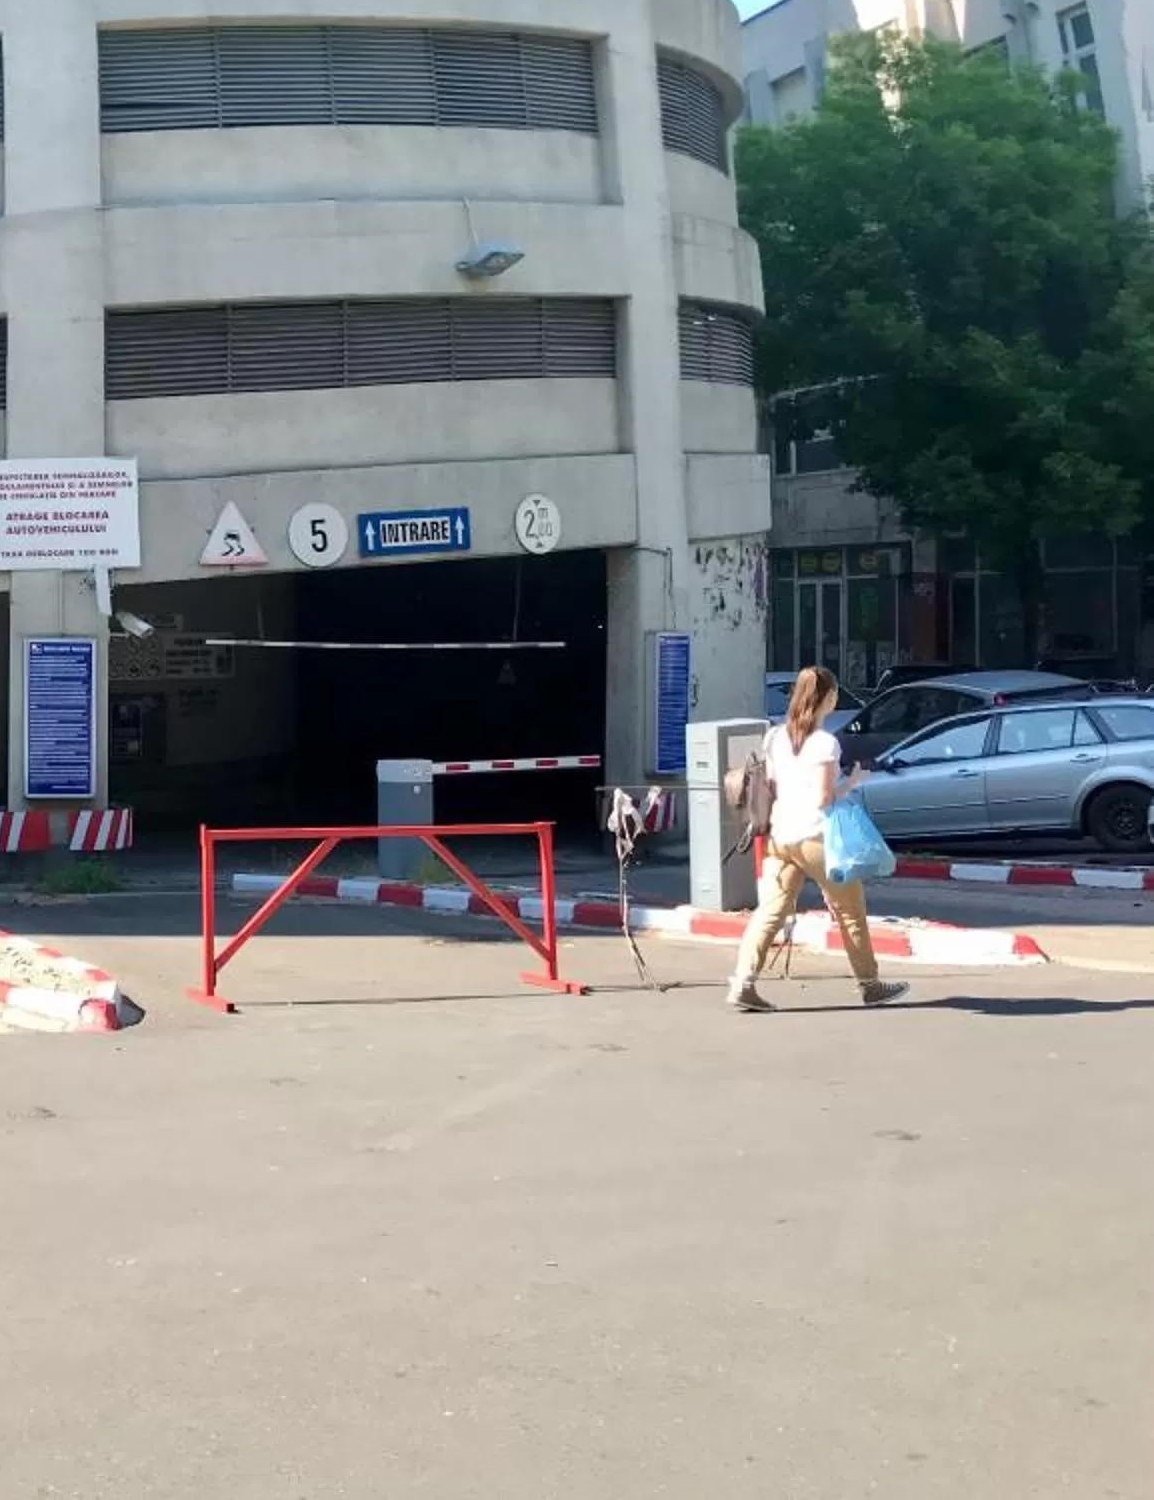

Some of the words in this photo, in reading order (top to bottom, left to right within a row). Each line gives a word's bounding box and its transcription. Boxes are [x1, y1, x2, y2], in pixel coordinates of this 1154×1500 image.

[6, 512, 49, 521] ATRAGE
[52, 510, 109, 521] BLOCAREA
[6, 524, 107, 535] AUTOVEHICULULUI
[311, 519, 327, 552] 5
[382, 520, 449, 544] INTRARE
